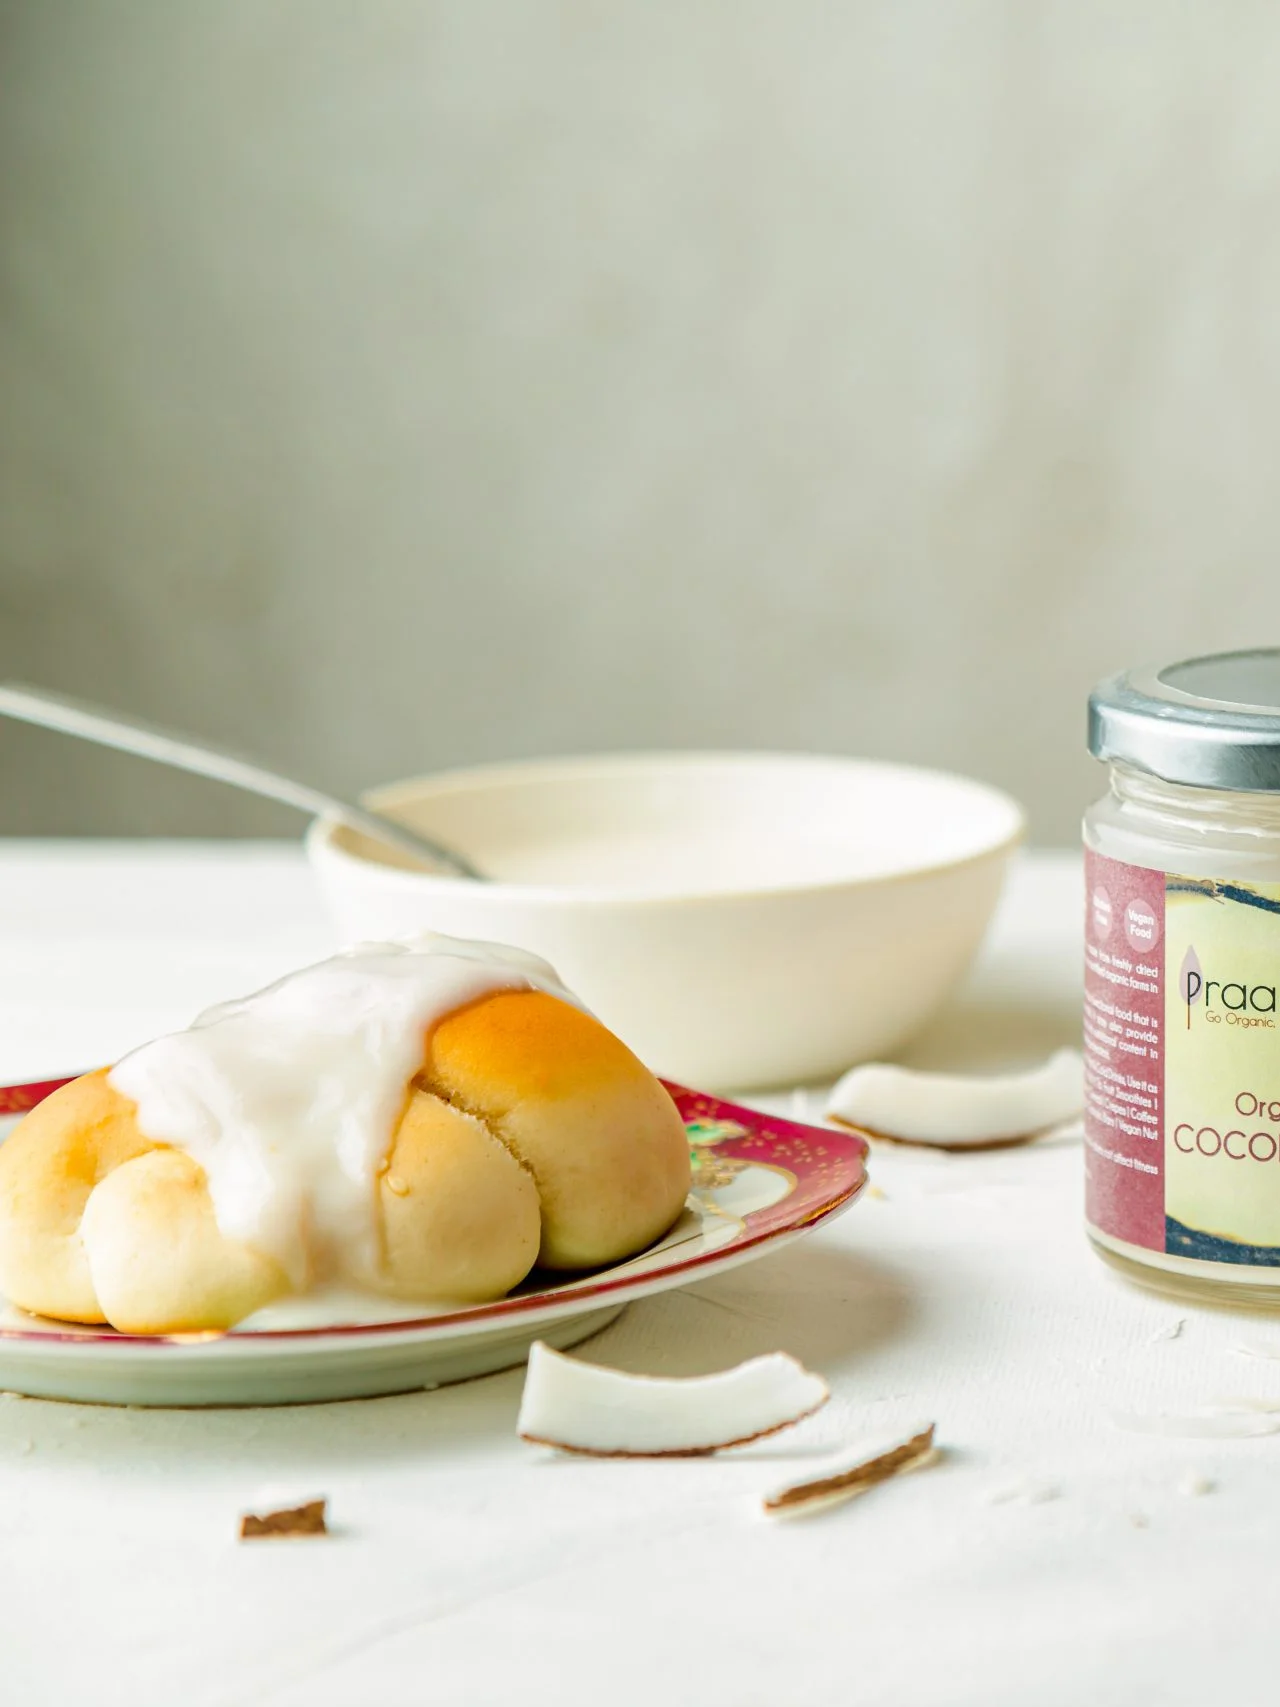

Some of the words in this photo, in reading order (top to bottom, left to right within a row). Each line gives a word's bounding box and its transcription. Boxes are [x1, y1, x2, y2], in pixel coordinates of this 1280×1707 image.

[1128, 908, 1155, 926] Vegan
[1129, 924, 1152, 940] Food
[1135, 963, 1159, 979] dried
[1130, 976, 1150, 993] farms
[1133, 1012, 1150, 1027] that
[1205, 1011, 1222, 1023] Go
[1126, 1027, 1159, 1044] provide
[1118, 1041, 1147, 1057] content
[1147, 1083, 1159, 1094] as
[1130, 1107, 1159, 1125] Coffee
[1119, 1120, 1142, 1136] Vegan
[1142, 1125, 1159, 1140] Nut
